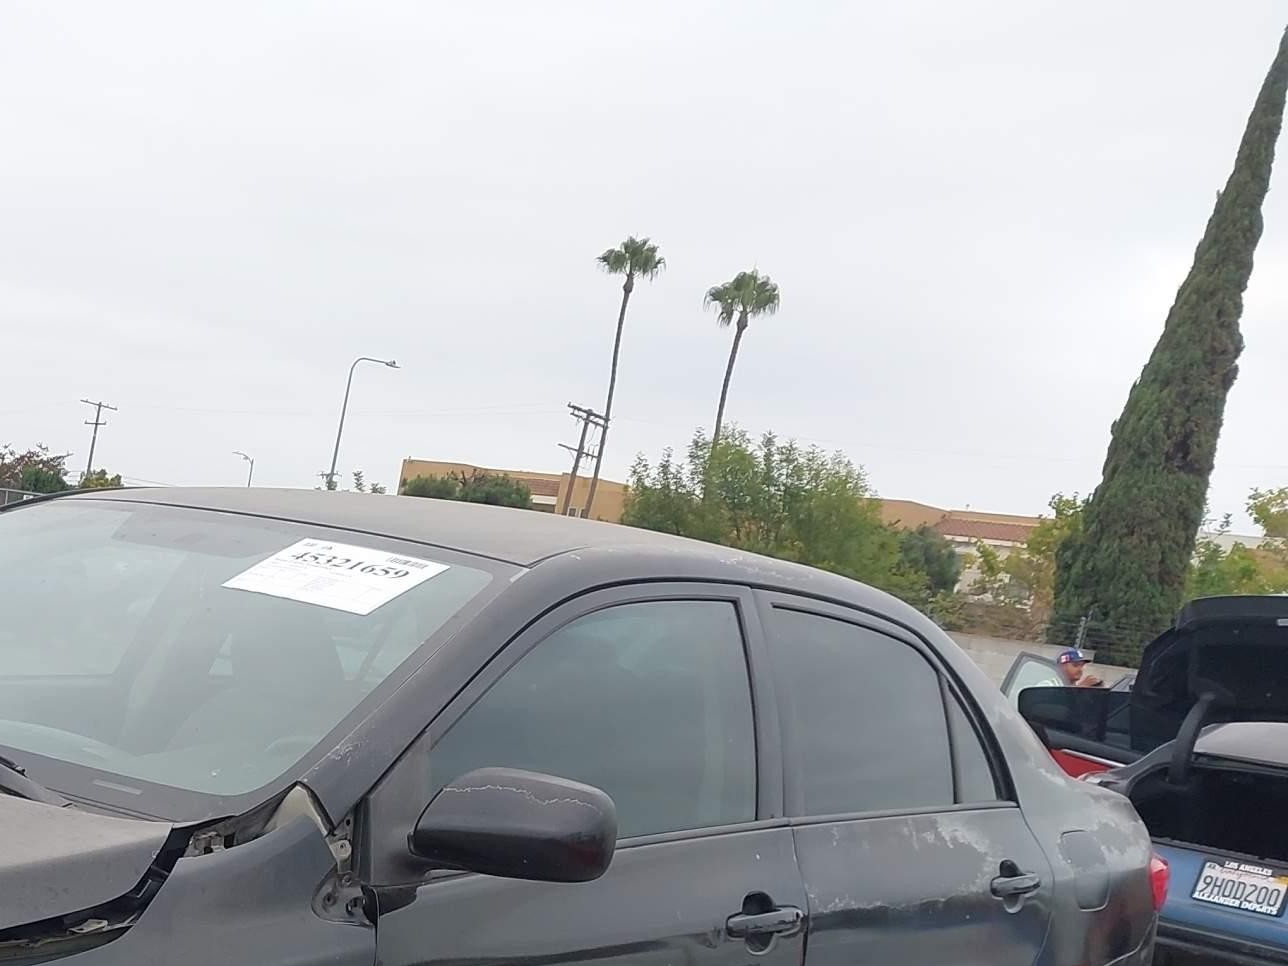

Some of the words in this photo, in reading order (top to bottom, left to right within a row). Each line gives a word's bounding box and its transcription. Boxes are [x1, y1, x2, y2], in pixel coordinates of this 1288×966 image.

[291, 551, 410, 579] 45321659
[1223, 861, 1238, 869] LOS
[1239, 863, 1273, 876] ANGELES
[1192, 891, 1241, 908] ALEXANDER
